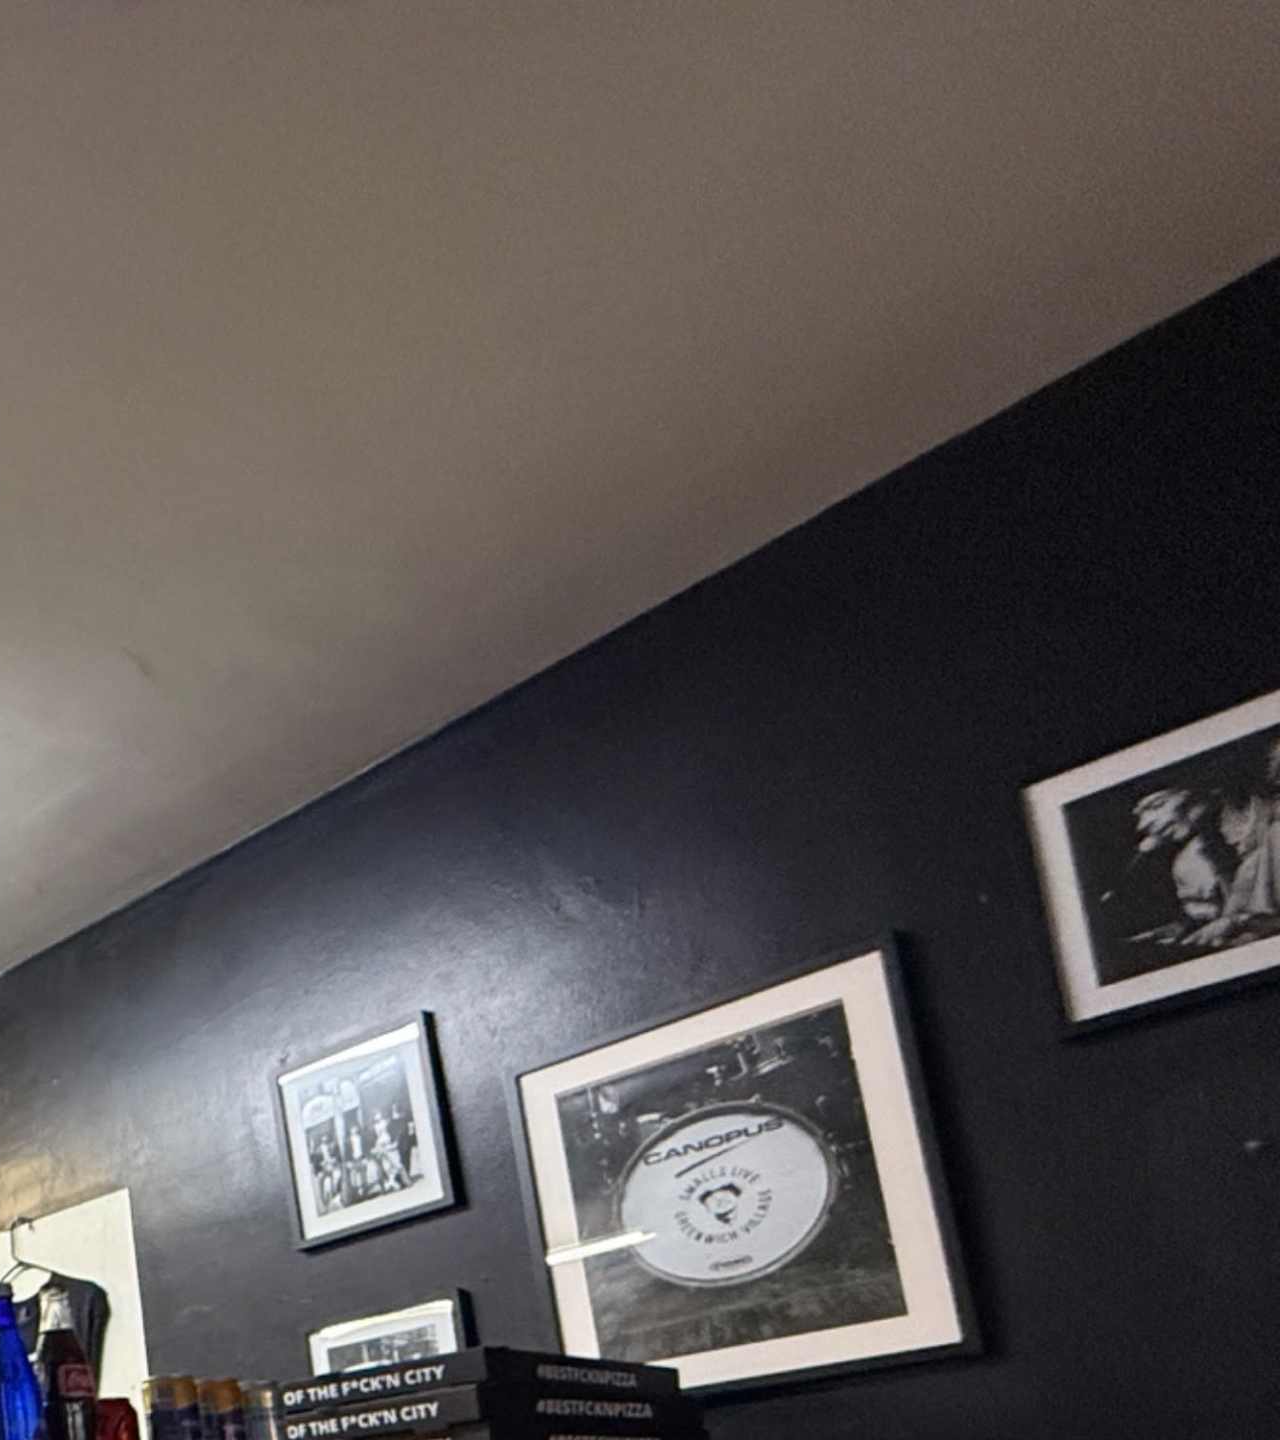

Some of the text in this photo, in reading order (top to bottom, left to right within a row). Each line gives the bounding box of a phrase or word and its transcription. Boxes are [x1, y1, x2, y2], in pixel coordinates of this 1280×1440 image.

[643, 1116, 785, 1166] CANOPUS
[283, 1390, 305, 1406] OF
[306, 1383, 339, 1403] THE
[404, 1364, 446, 1386] CITY
[308, 1417, 340, 1438] THE
[400, 1401, 439, 1422] CITY
